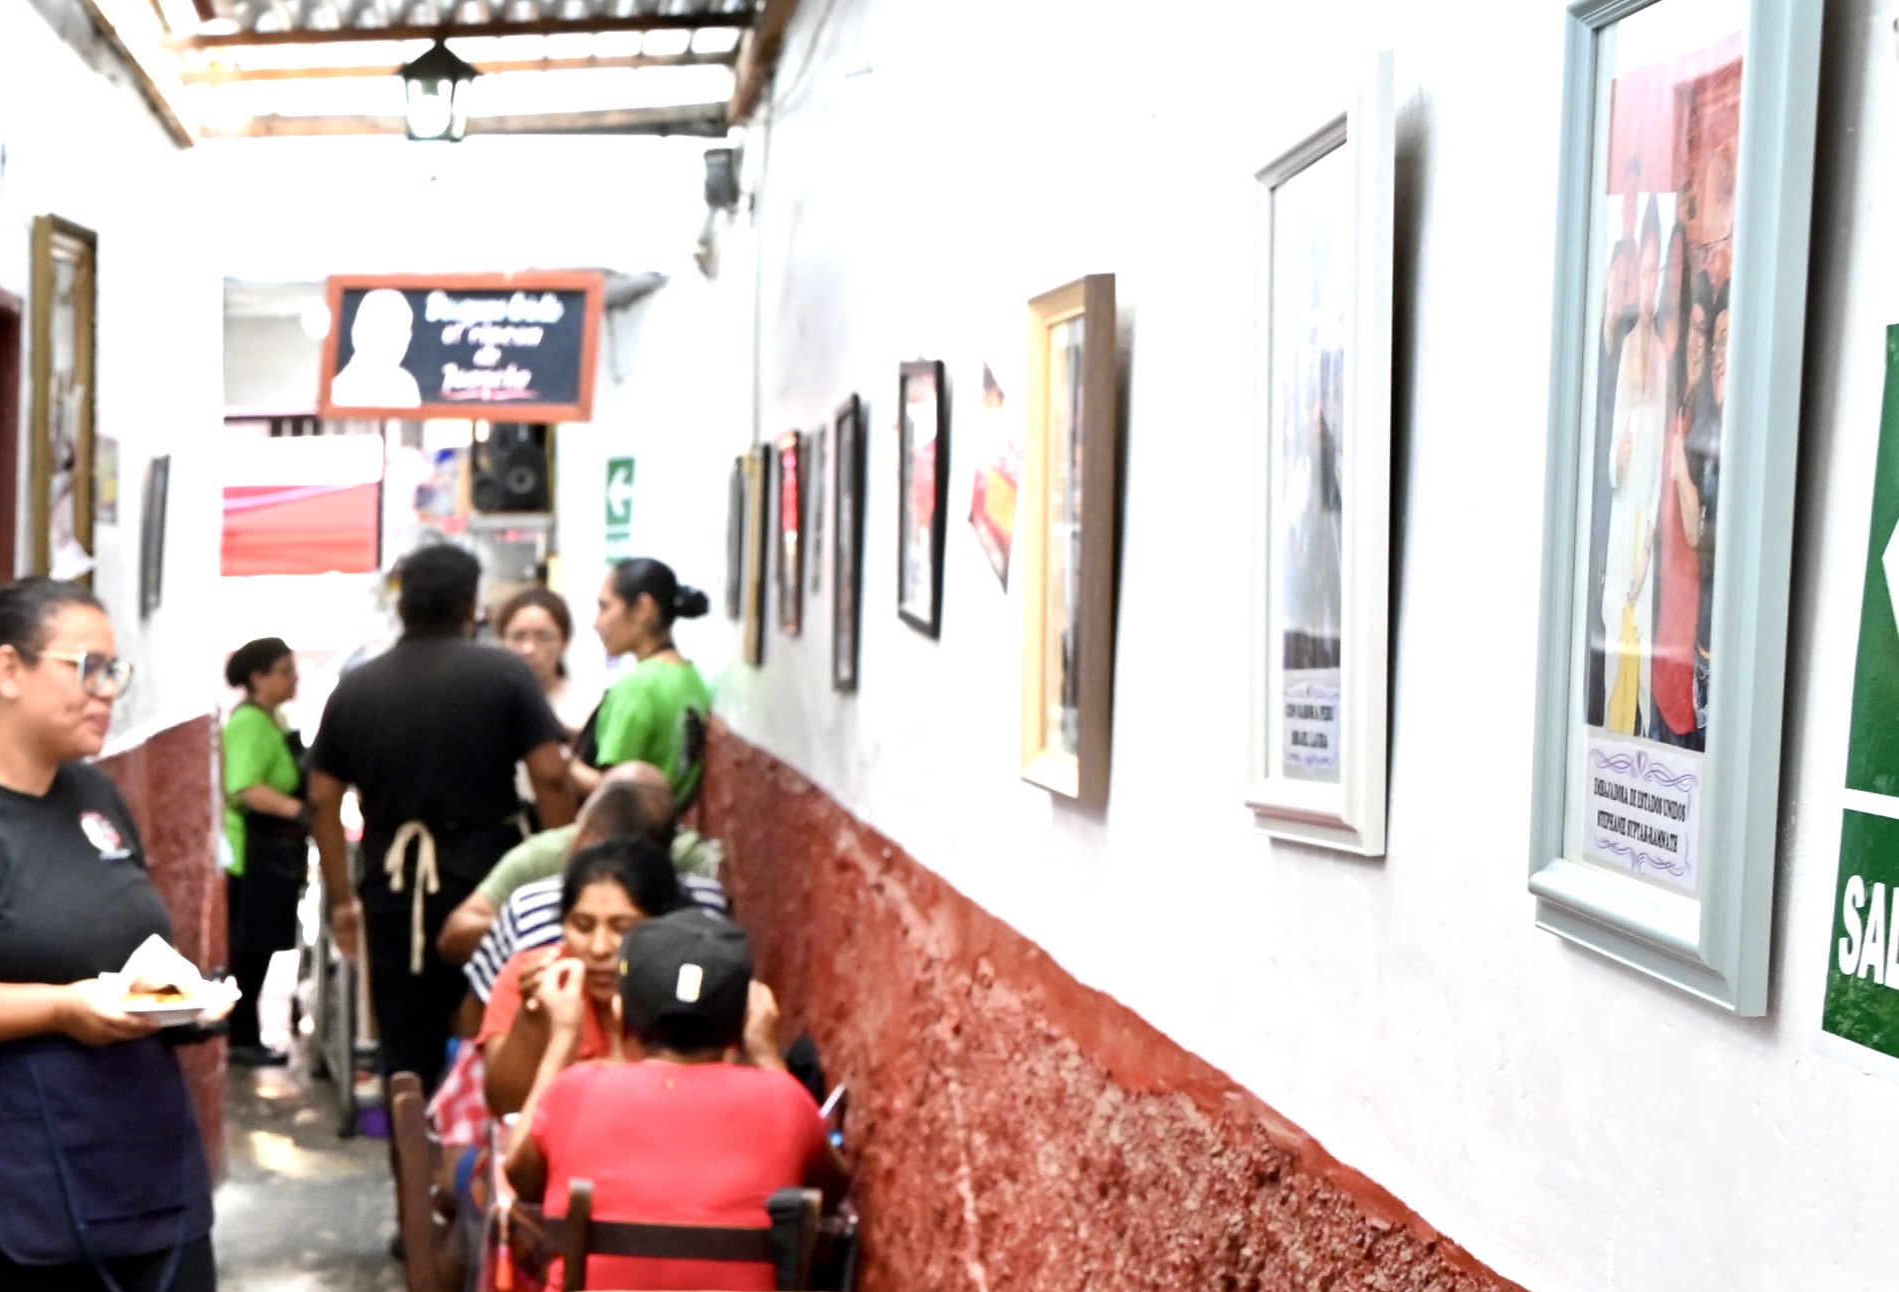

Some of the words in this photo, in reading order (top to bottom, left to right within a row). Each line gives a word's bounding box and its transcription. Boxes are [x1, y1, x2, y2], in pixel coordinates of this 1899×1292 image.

[1629, 787, 1637, 807] DE
[1637, 789, 1662, 815] ESTADOS
[1663, 798, 1686, 823] UNIDOS
